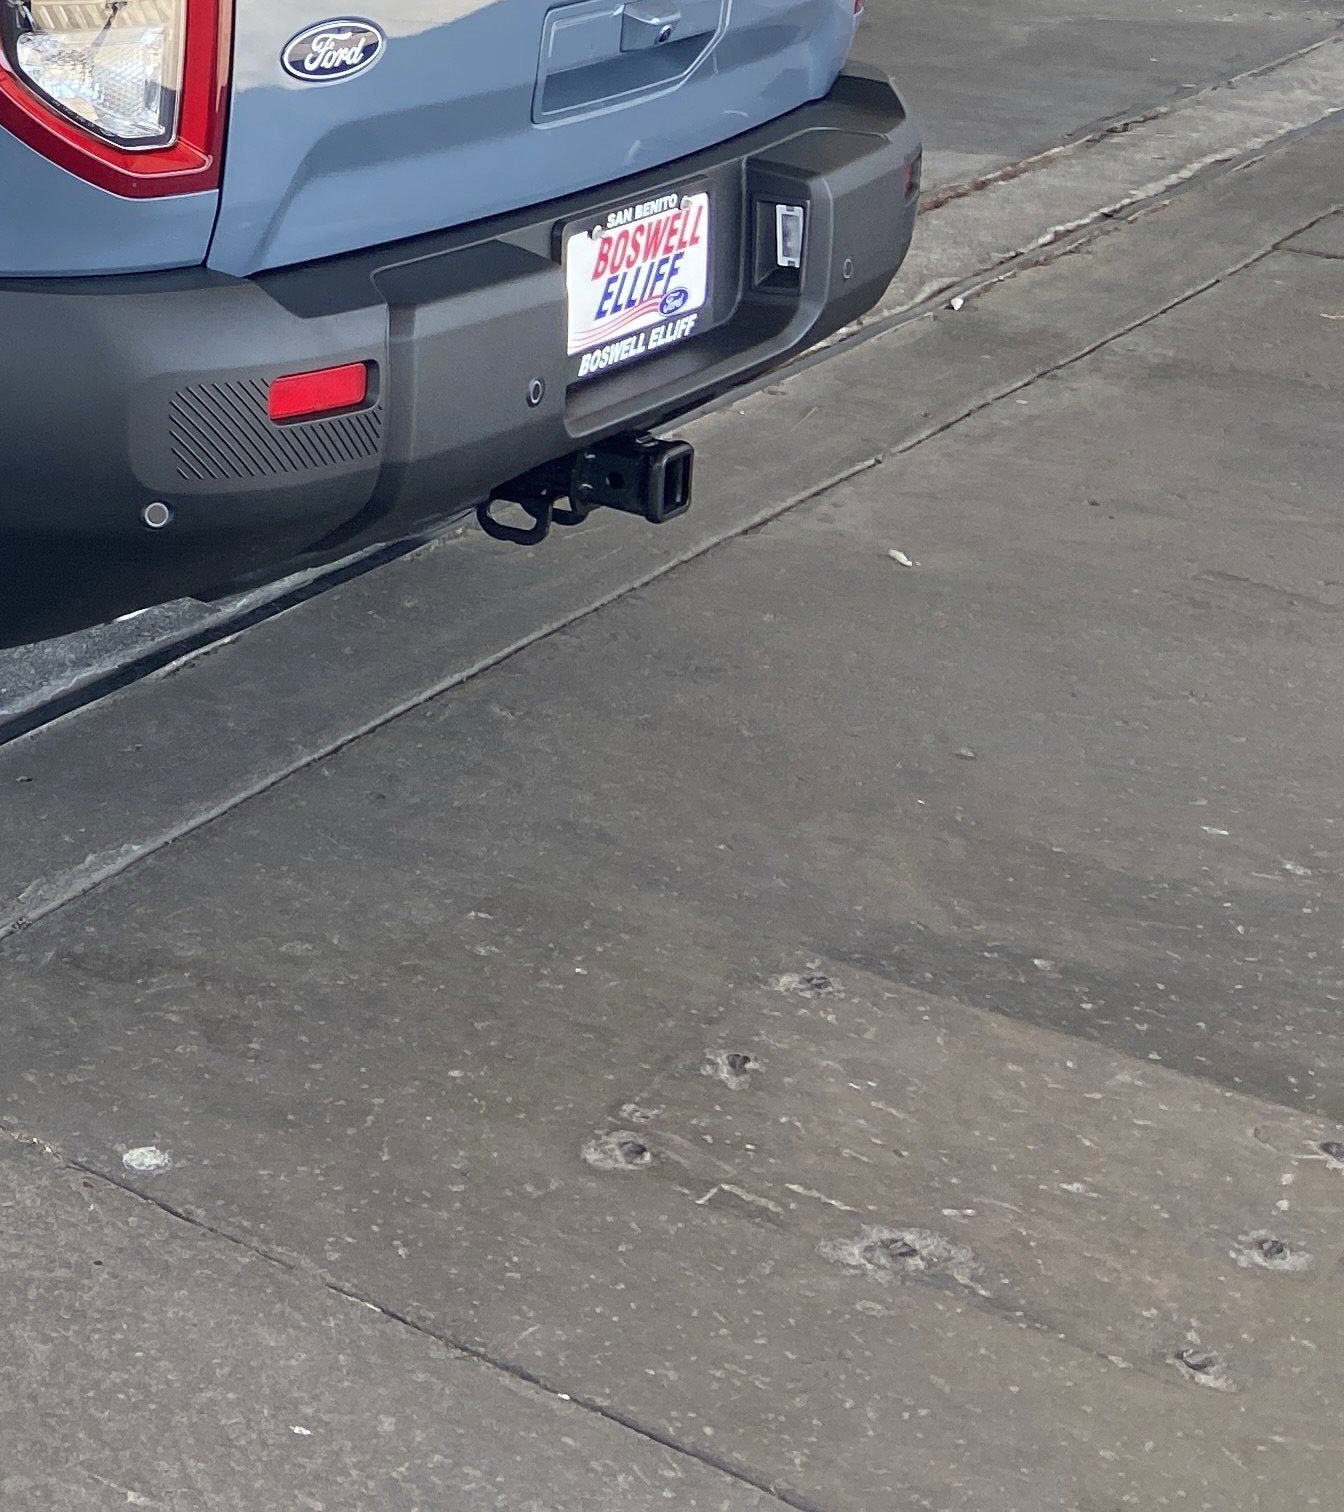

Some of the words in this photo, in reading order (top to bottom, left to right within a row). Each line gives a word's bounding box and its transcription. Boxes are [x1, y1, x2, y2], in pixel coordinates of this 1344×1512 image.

[304, 31, 366, 71] Ford
[606, 207, 633, 229] SAN
[634, 193, 678, 218] BENITO
[591, 205, 704, 282] BOSWELL
[593, 252, 685, 321] ELLIFF
[577, 334, 646, 377] BOSWELL
[648, 313, 698, 350] ELLIFF
